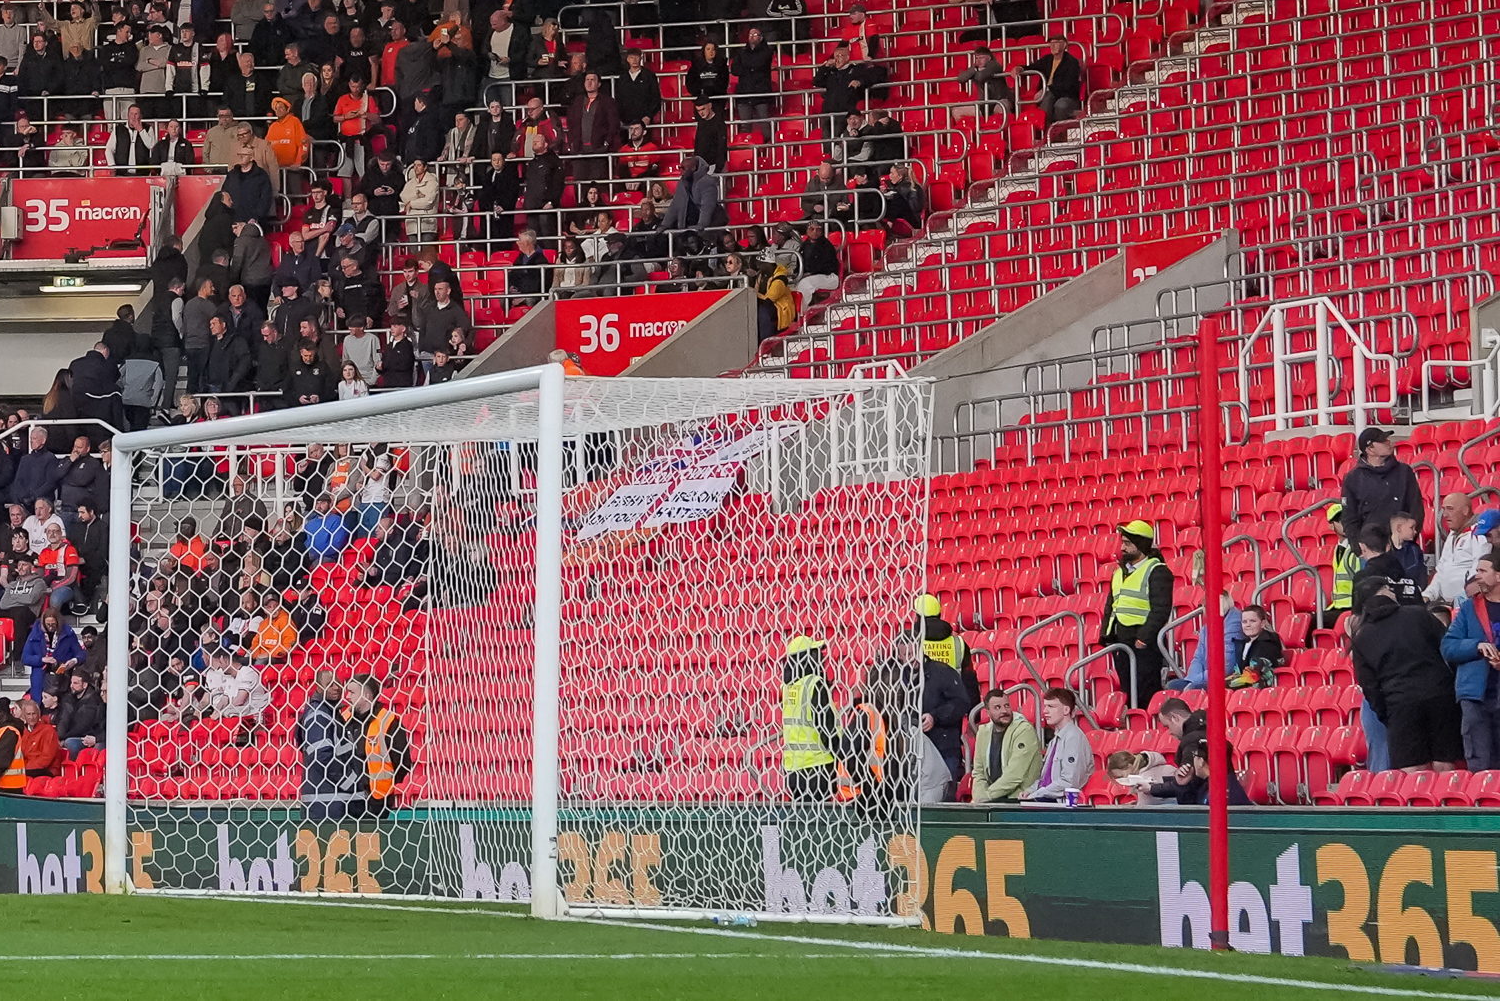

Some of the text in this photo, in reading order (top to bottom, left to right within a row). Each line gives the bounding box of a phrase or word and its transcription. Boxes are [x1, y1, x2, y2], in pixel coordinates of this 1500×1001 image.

[25, 199, 141, 232] 35 macron
[579, 313, 621, 354] 36
[16, 823, 154, 894] bet35
[218, 824, 382, 893] bet365
[459, 824, 661, 905] be365
[762, 825, 1030, 938] bet365
[1155, 831, 1500, 973] bet365
